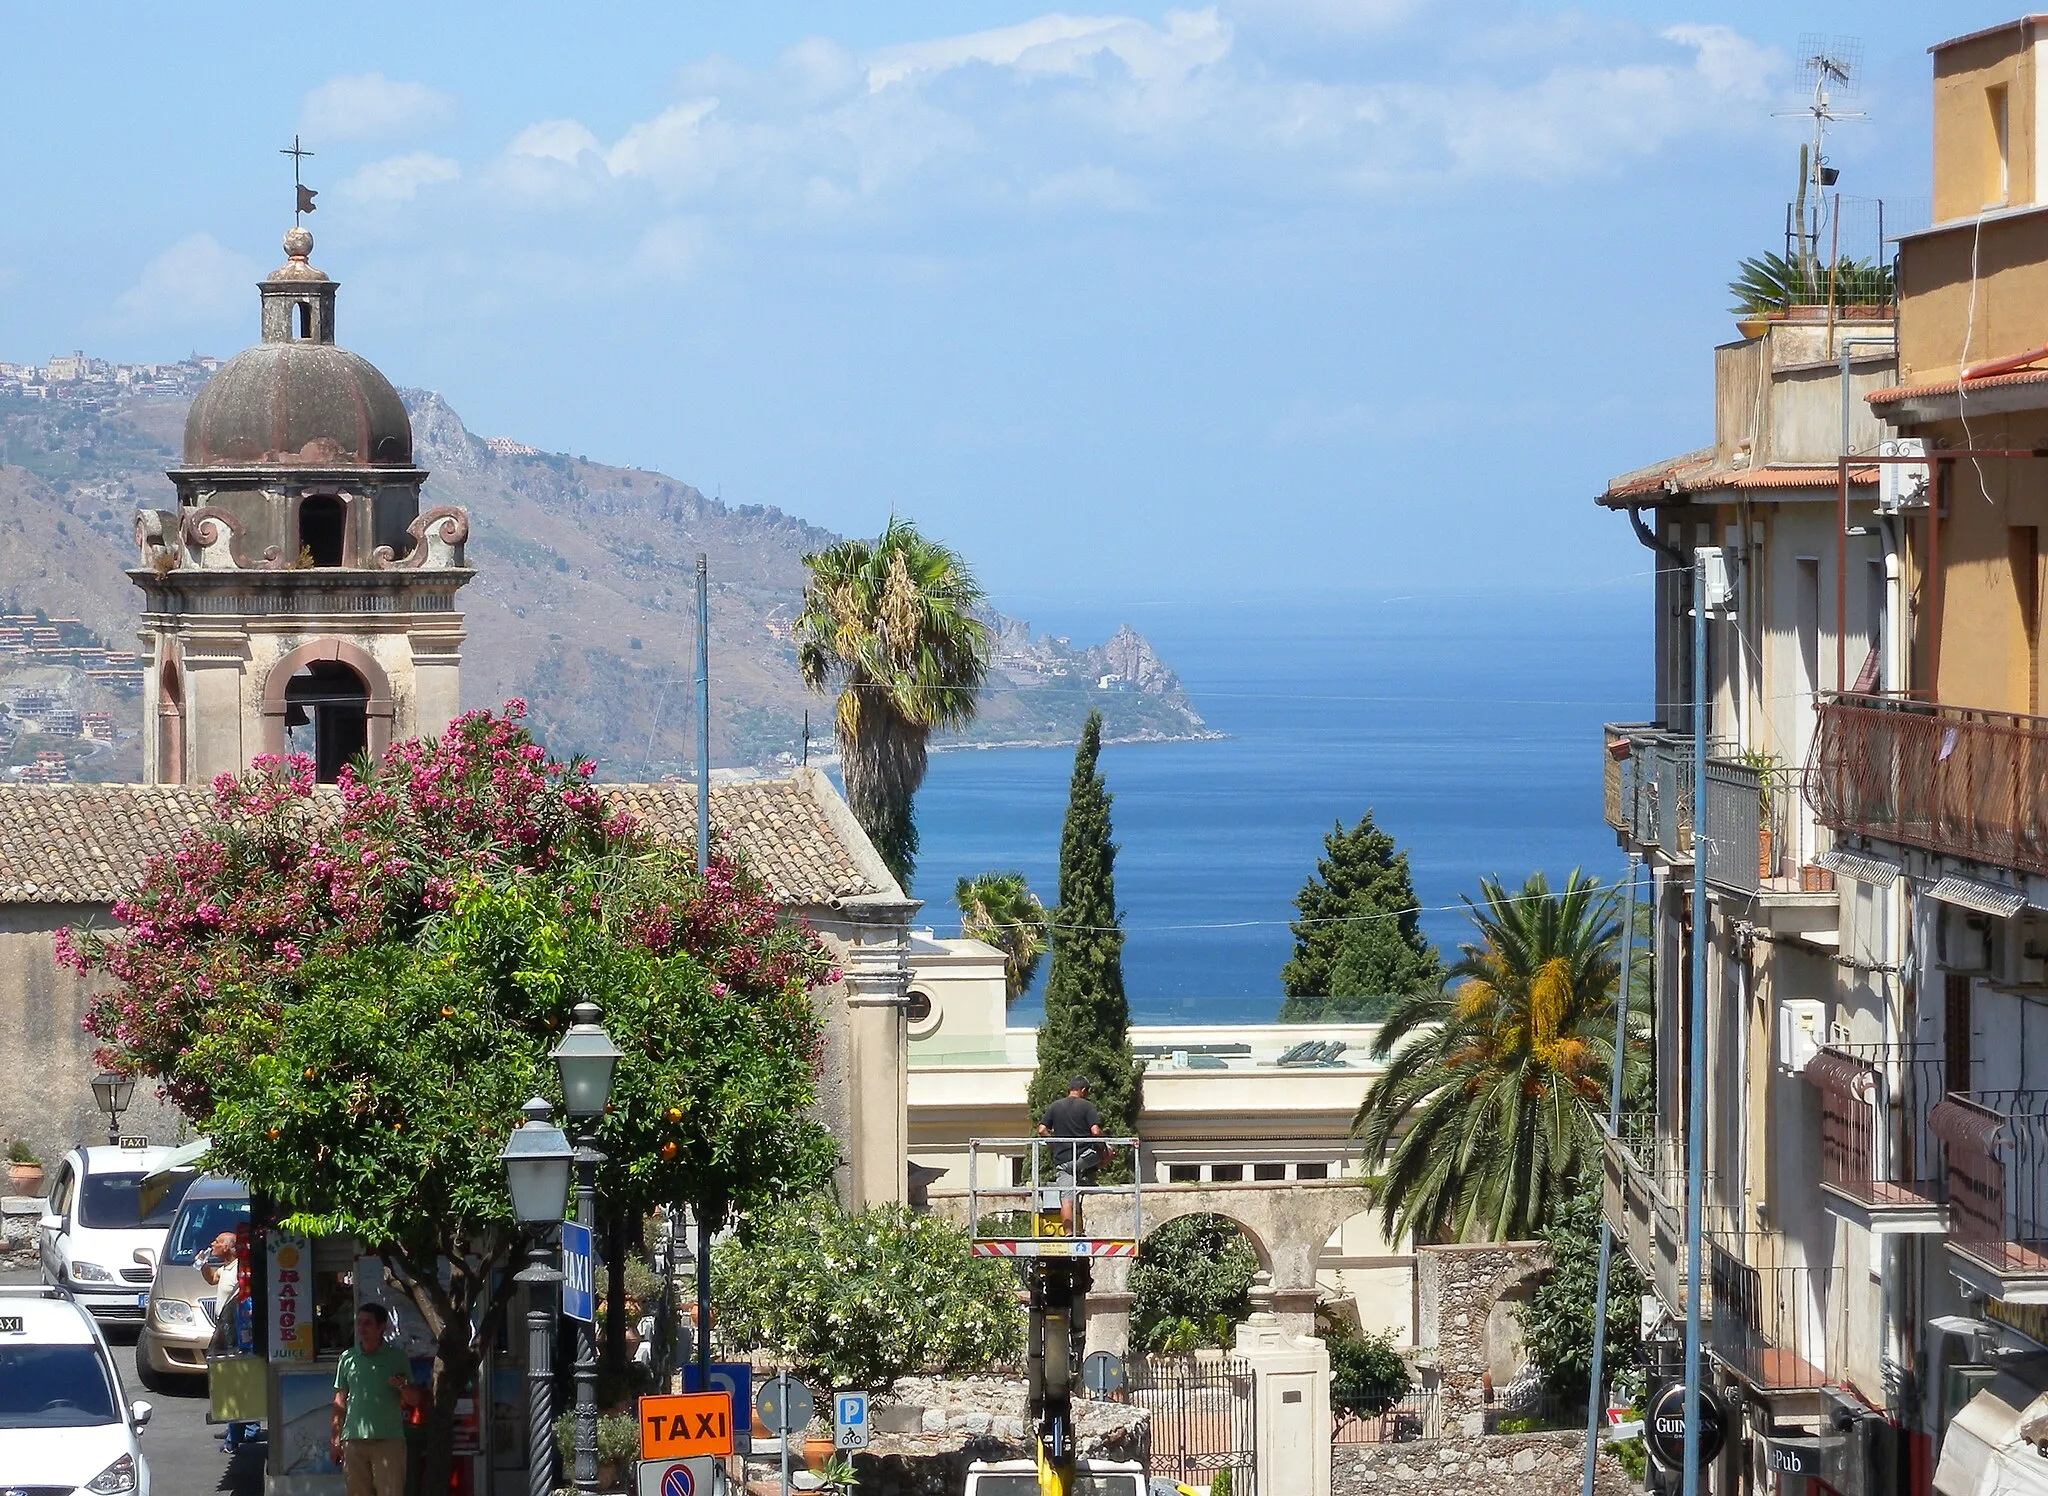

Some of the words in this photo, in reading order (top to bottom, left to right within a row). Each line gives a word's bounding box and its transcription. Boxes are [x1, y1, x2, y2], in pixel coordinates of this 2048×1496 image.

[121, 1138, 145, 1147] TAXI
[564, 1249, 589, 1293] TAXI
[273, 1347, 308, 1358] JUICE
[845, 1401, 859, 1424] P
[647, 1412, 726, 1442] TAXI
